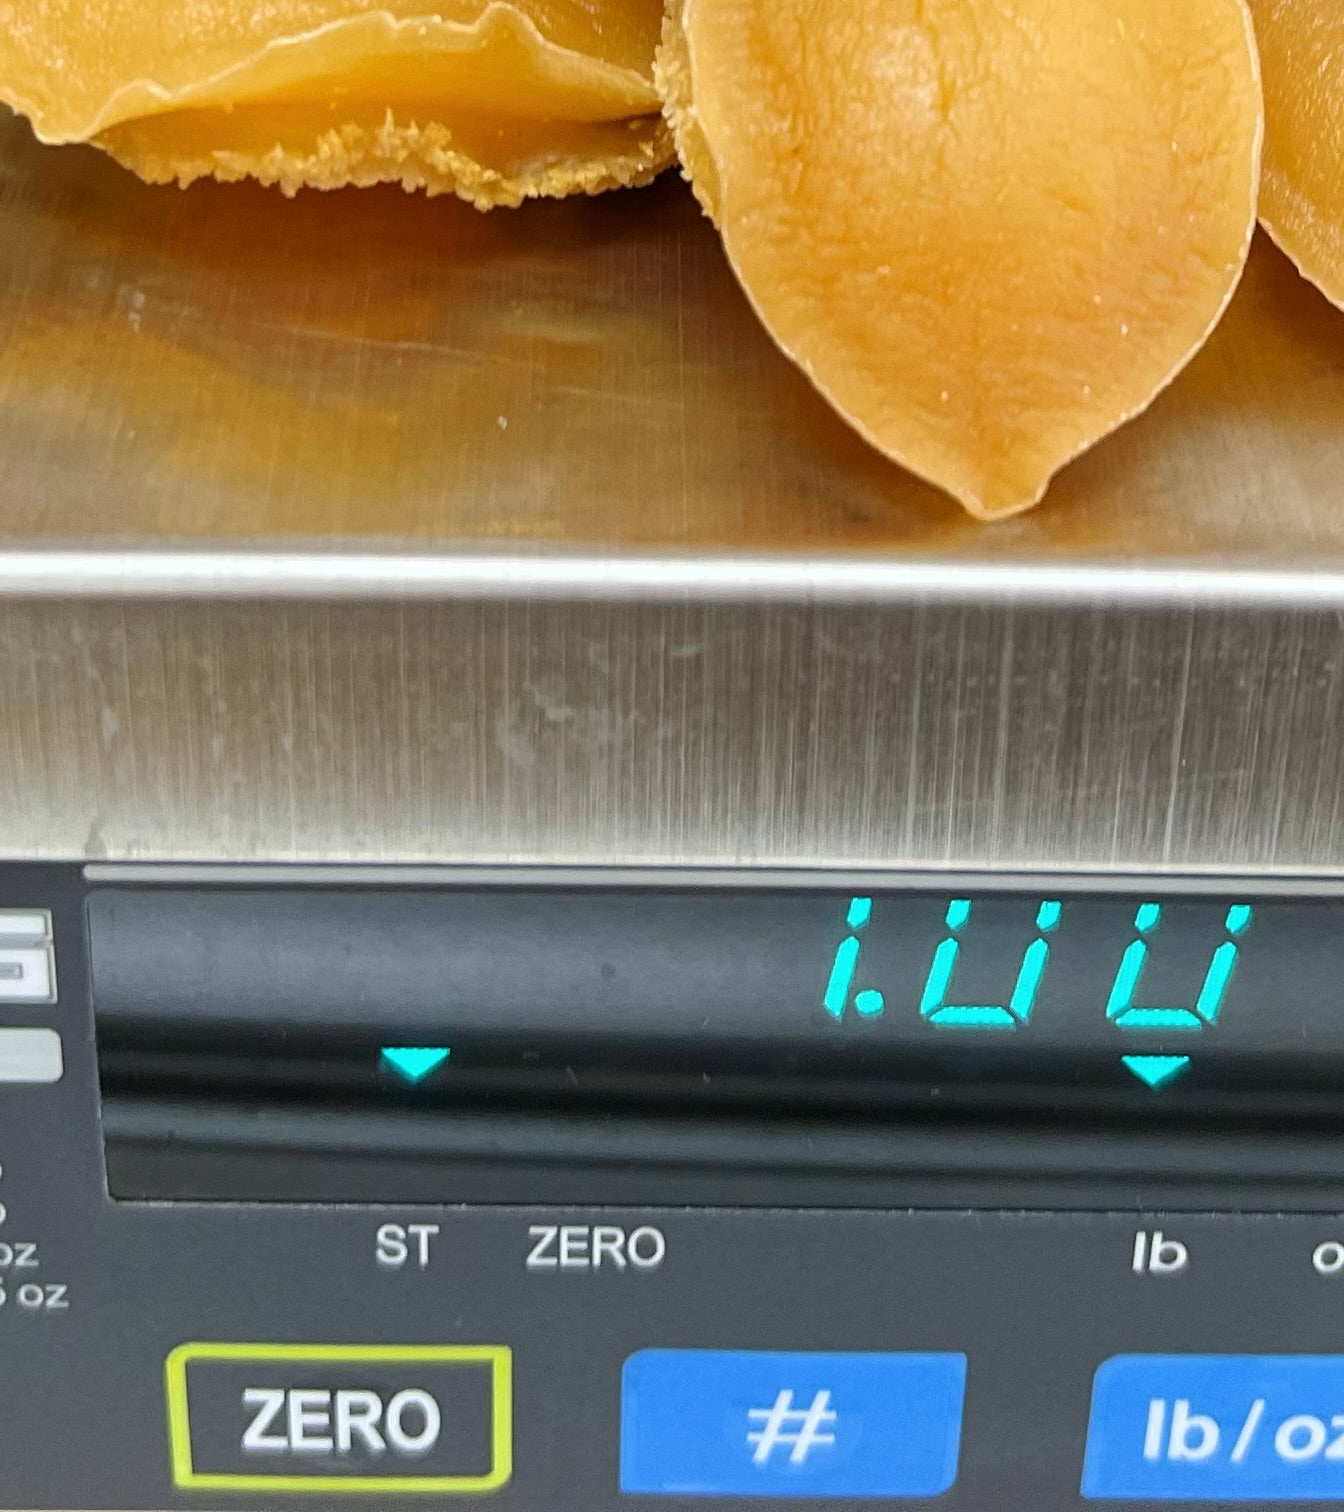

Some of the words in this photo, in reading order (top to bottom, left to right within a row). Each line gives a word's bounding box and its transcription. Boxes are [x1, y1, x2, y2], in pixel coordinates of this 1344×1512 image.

[376, 1224, 441, 1267] ST
[526, 1225, 666, 1269] ZERO
[1132, 1230, 1188, 1274] lb
[17, 1284, 70, 1310] oz
[241, 1387, 441, 1454] ZERO
